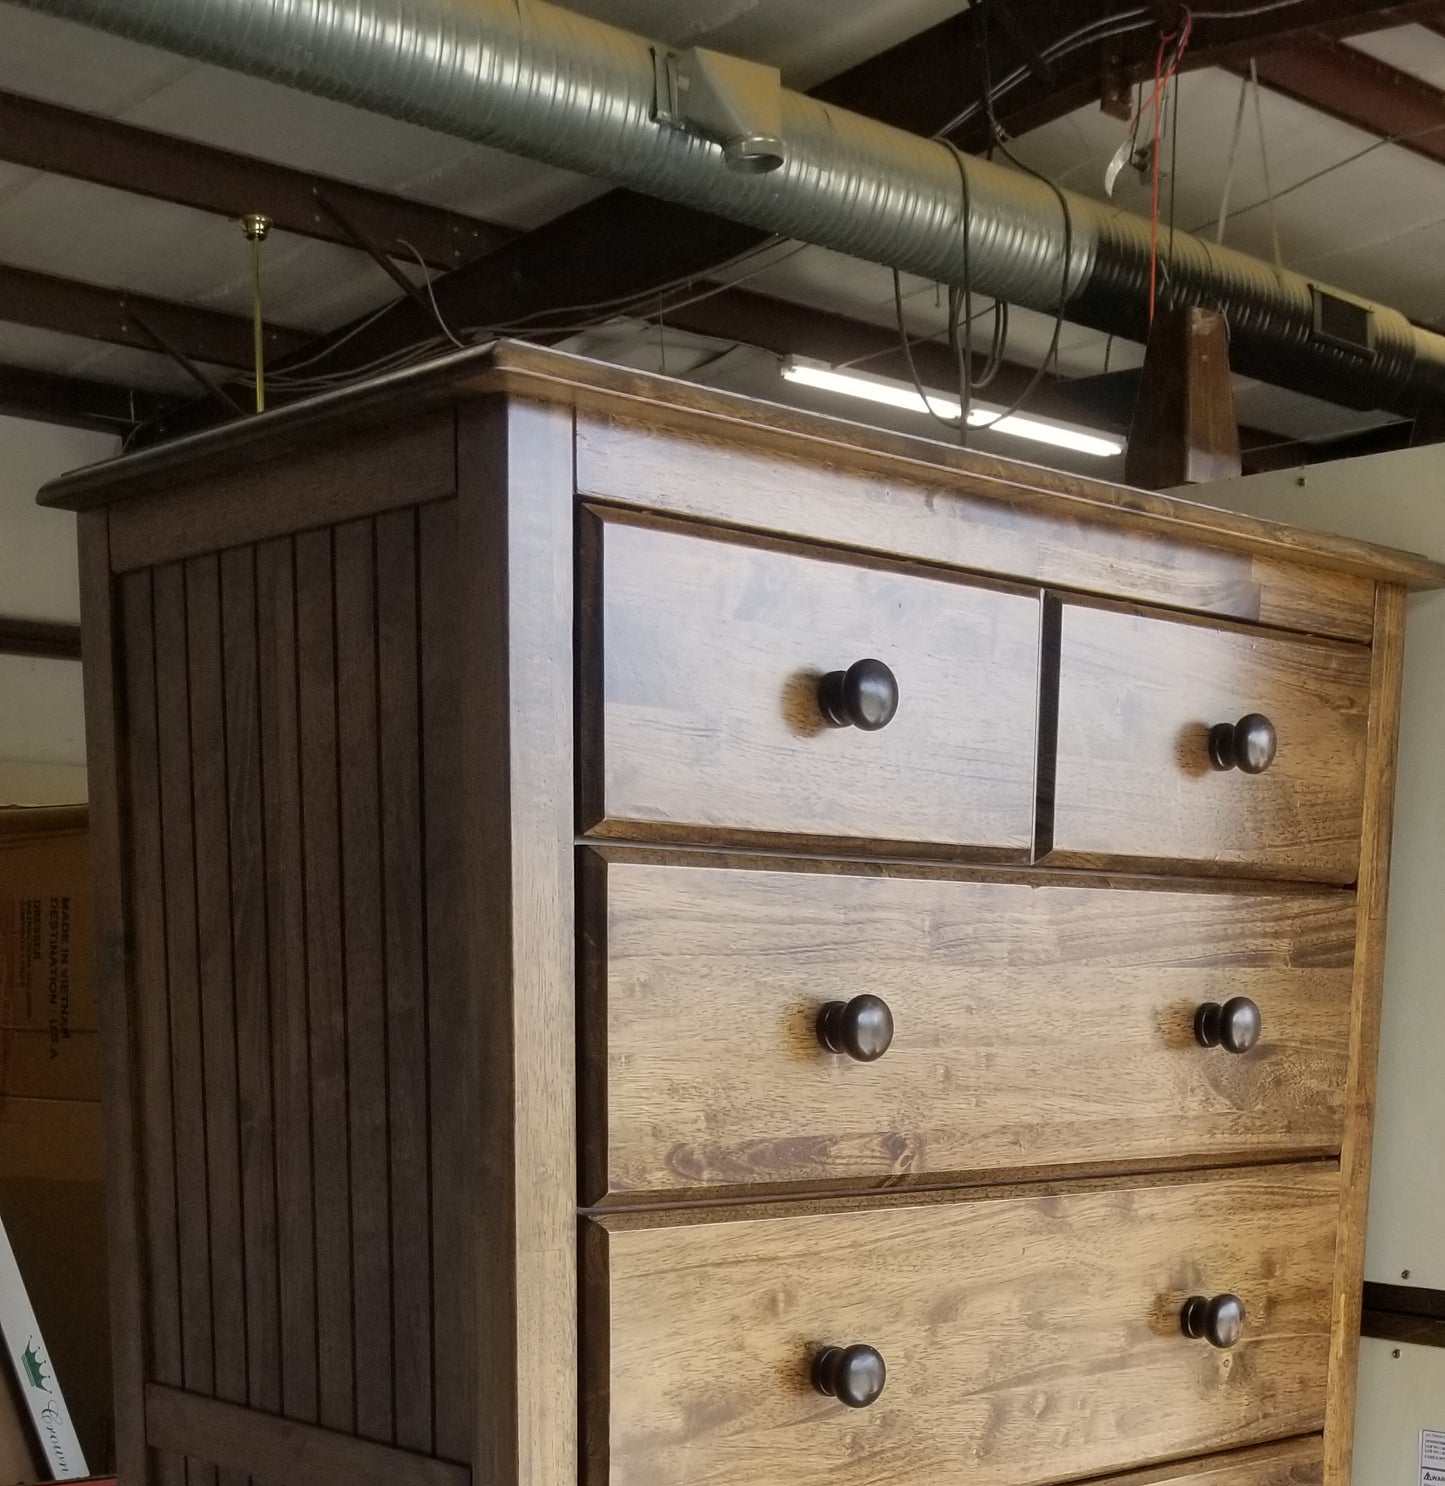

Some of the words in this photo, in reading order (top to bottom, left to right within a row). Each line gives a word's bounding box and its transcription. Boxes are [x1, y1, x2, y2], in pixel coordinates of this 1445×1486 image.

[49, 897, 59, 1004] DESTINATION
[61, 897, 70, 944] MADE
[61, 949, 70, 964] IN
[60, 968, 70, 1039] VIETNAM
[41, 1400, 69, 1473] Crown
